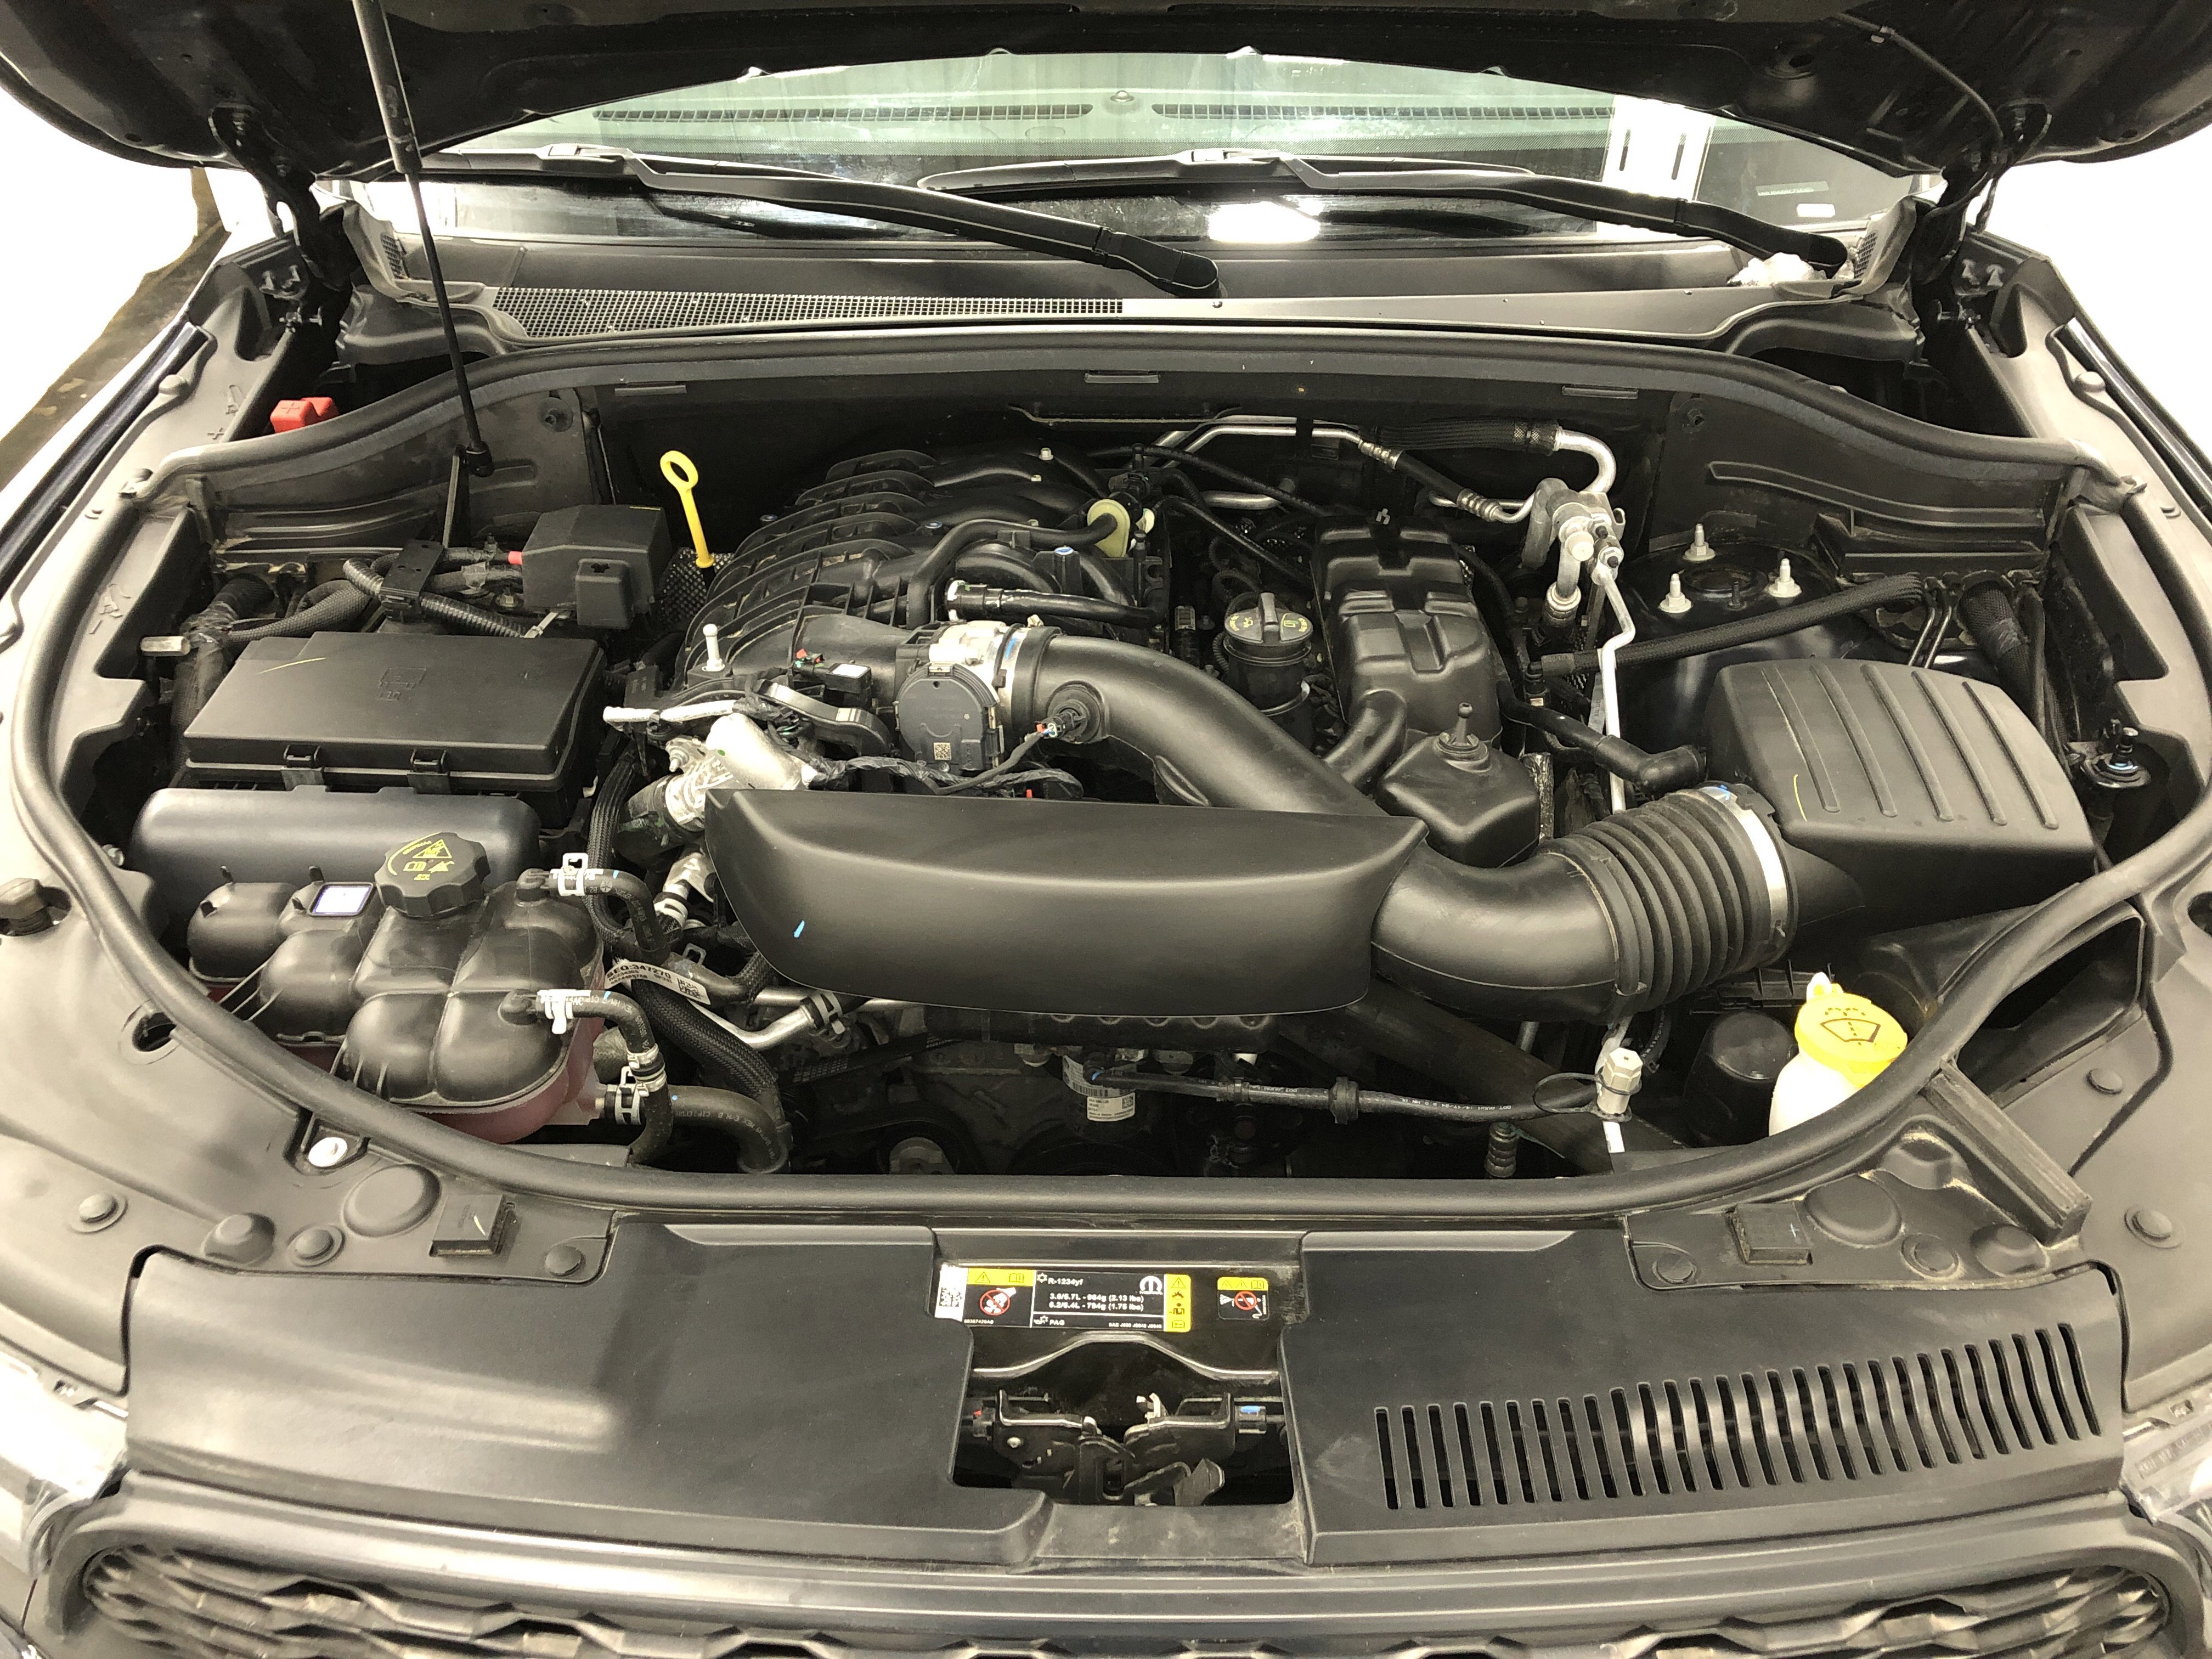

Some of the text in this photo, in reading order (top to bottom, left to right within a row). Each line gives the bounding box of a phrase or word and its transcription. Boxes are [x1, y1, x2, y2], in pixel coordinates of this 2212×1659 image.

[1048, 1277, 1084, 1286] R-1234yf
[1109, 1294, 1127, 1302] (2.13
[1108, 1302, 1127, 1311] (1.75
